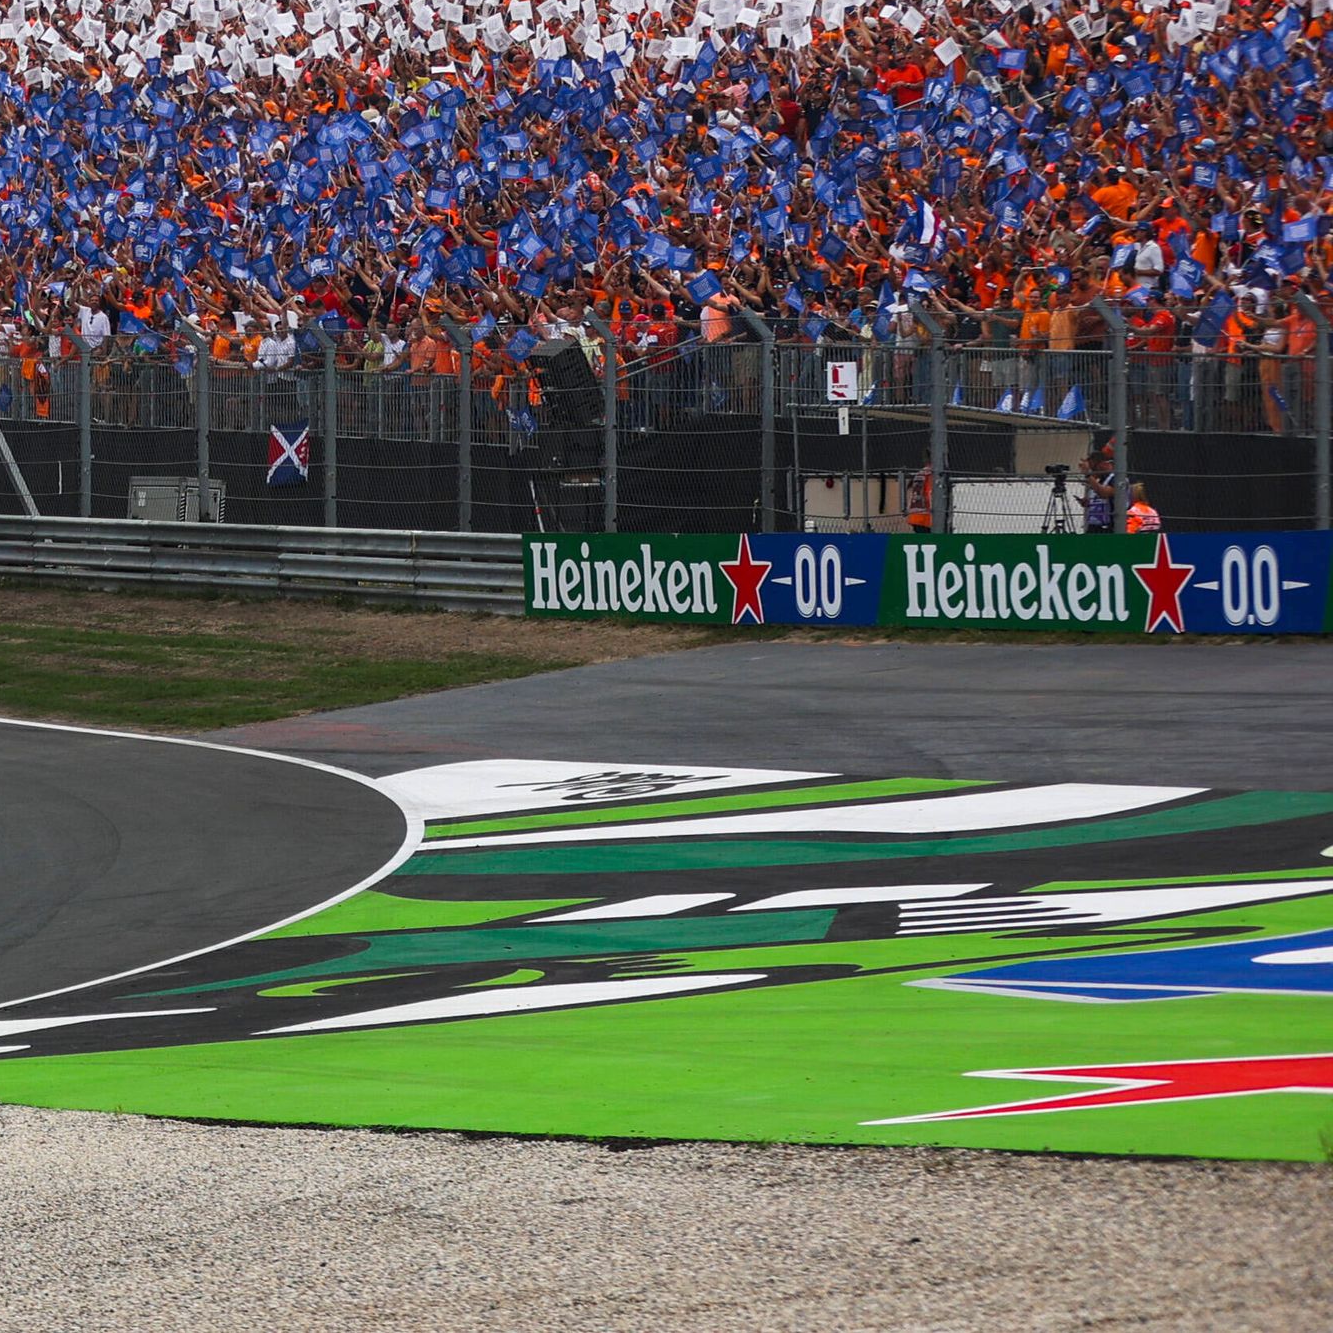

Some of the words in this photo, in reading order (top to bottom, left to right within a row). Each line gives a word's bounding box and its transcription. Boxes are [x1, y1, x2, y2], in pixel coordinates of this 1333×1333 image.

[530, 541, 718, 614] Heineken
[794, 544, 842, 618] 0.0
[903, 543, 1130, 622] Heineken
[1222, 545, 1279, 626] 0.0
